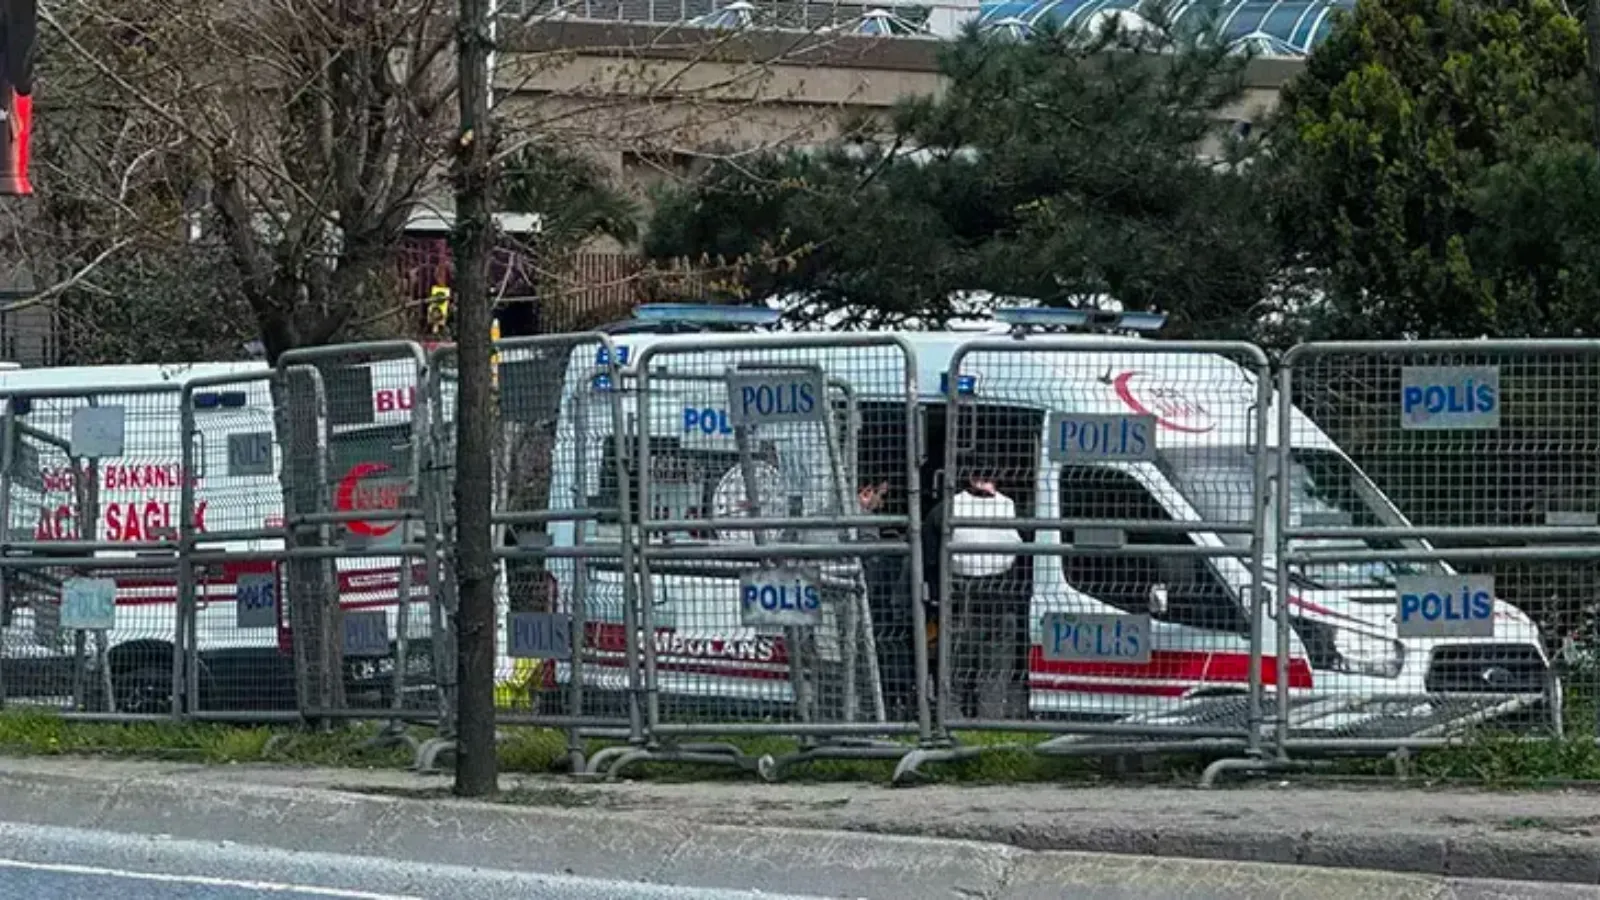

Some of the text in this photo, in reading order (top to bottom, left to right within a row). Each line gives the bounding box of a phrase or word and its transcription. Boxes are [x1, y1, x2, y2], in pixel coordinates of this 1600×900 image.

[1404, 377, 1495, 414] POLİS
[684, 407, 733, 435] POL
[743, 579, 820, 611] POLİS
[1401, 585, 1491, 622] POLİS
